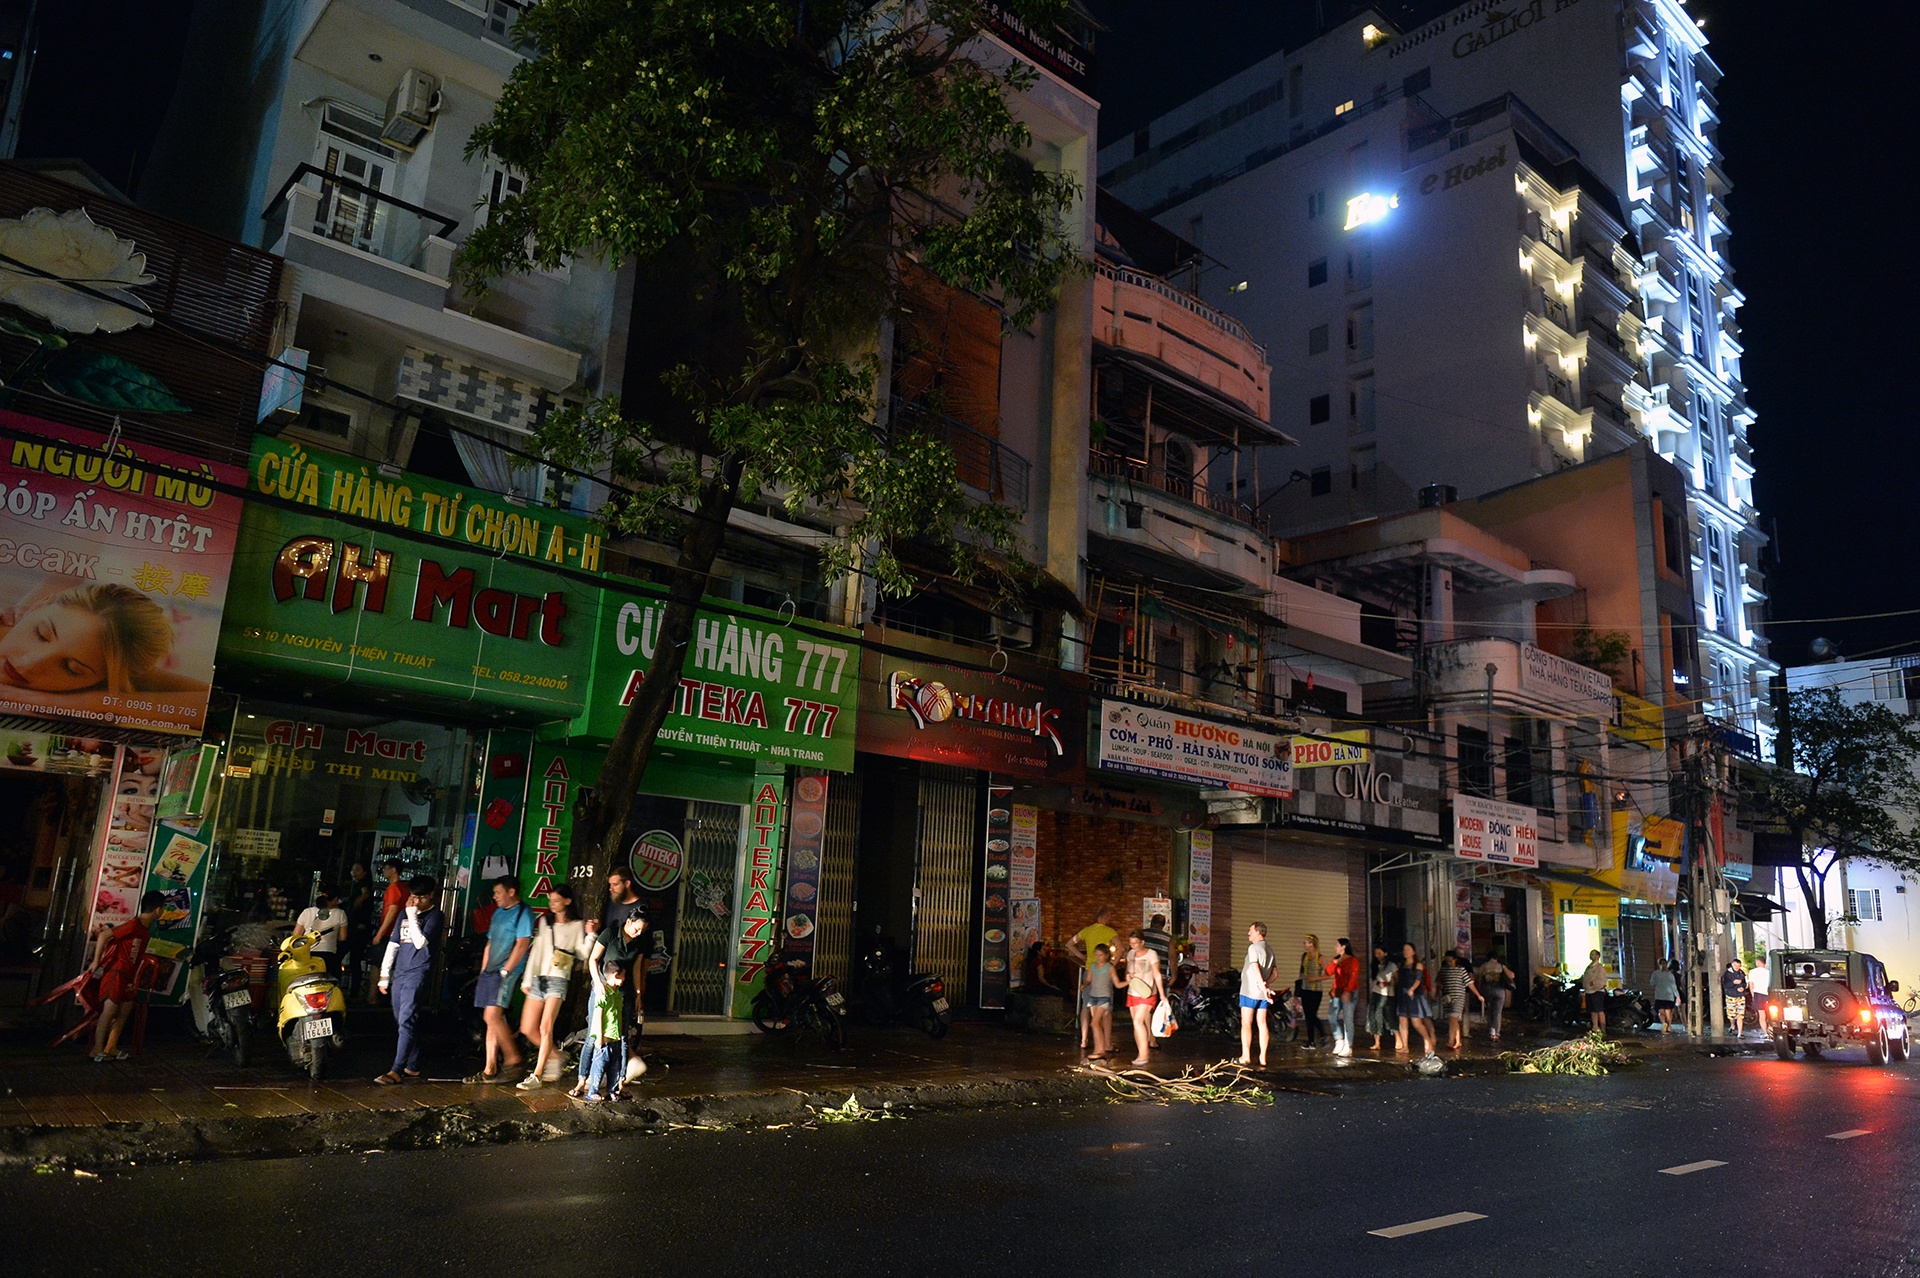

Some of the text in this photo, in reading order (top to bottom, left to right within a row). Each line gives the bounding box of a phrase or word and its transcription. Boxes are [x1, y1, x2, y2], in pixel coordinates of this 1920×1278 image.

[1057, 47, 1086, 76] MEZE
[1442, 145, 1506, 191] Hotel
[61, 489, 118, 534] ẤN
[123, 514, 212, 554] HYỆT
[257, 442, 319, 506] CỬA
[329, 466, 413, 529] HÀNG
[545, 525, 564, 564] A
[581, 533, 601, 572] H
[132, 561, 212, 599] 按摩
[271, 534, 567, 647] AH Mart
[348, 644, 387, 662] THIỆN
[392, 651, 435, 669] THUẬT
[694, 615, 784, 683] HÀNG
[795, 639, 848, 694] 777
[1524, 646, 1547, 666] CÔNG
[1549, 657, 1559, 669] TY
[1560, 662, 1579, 678] TNHH
[471, 665, 497, 680] TEL:
[1569, 679, 1593, 697] TEXAS
[126, 699, 153, 712] 0905
[157, 703, 175, 715] 103
[179, 706, 197, 718] 705
[784, 697, 840, 739] 777
[265, 720, 427, 763] AH Mart
[696, 733, 727, 750] THIỆN
[729, 738, 762, 754] THUẬT
[770, 745, 791, 758] NHA
[792, 748, 824, 762] TRANG
[1110, 728, 1137, 744] CƠM
[1148, 735, 1174, 750] PHỞ
[1183, 740, 1203, 756] HẢI
[1207, 745, 1230, 761] SẢN
[1233, 752, 1259, 767] TƯƠI
[1137, 713, 1270, 754] Quán HƯƠNG HÀ NỘI
[1112, 744, 1173, 760] LUNCH SOUP SEAFOOD
[1334, 744, 1346, 760] HÀ
[325, 763, 362, 780] THỊ
[371, 767, 417, 784] MINI
[1334, 762, 1420, 809] CMC Leather
[529, 756, 570, 900] АПТЕКА
[1458, 816, 1484, 832] MODERN
[637, 842, 678, 868] АПТЕКА
[1461, 834, 1481, 850] HOUSE
[1517, 842, 1534, 857] MAI
[640, 861, 670, 884] 777
[738, 782, 778, 984] АПТЕКА 777
